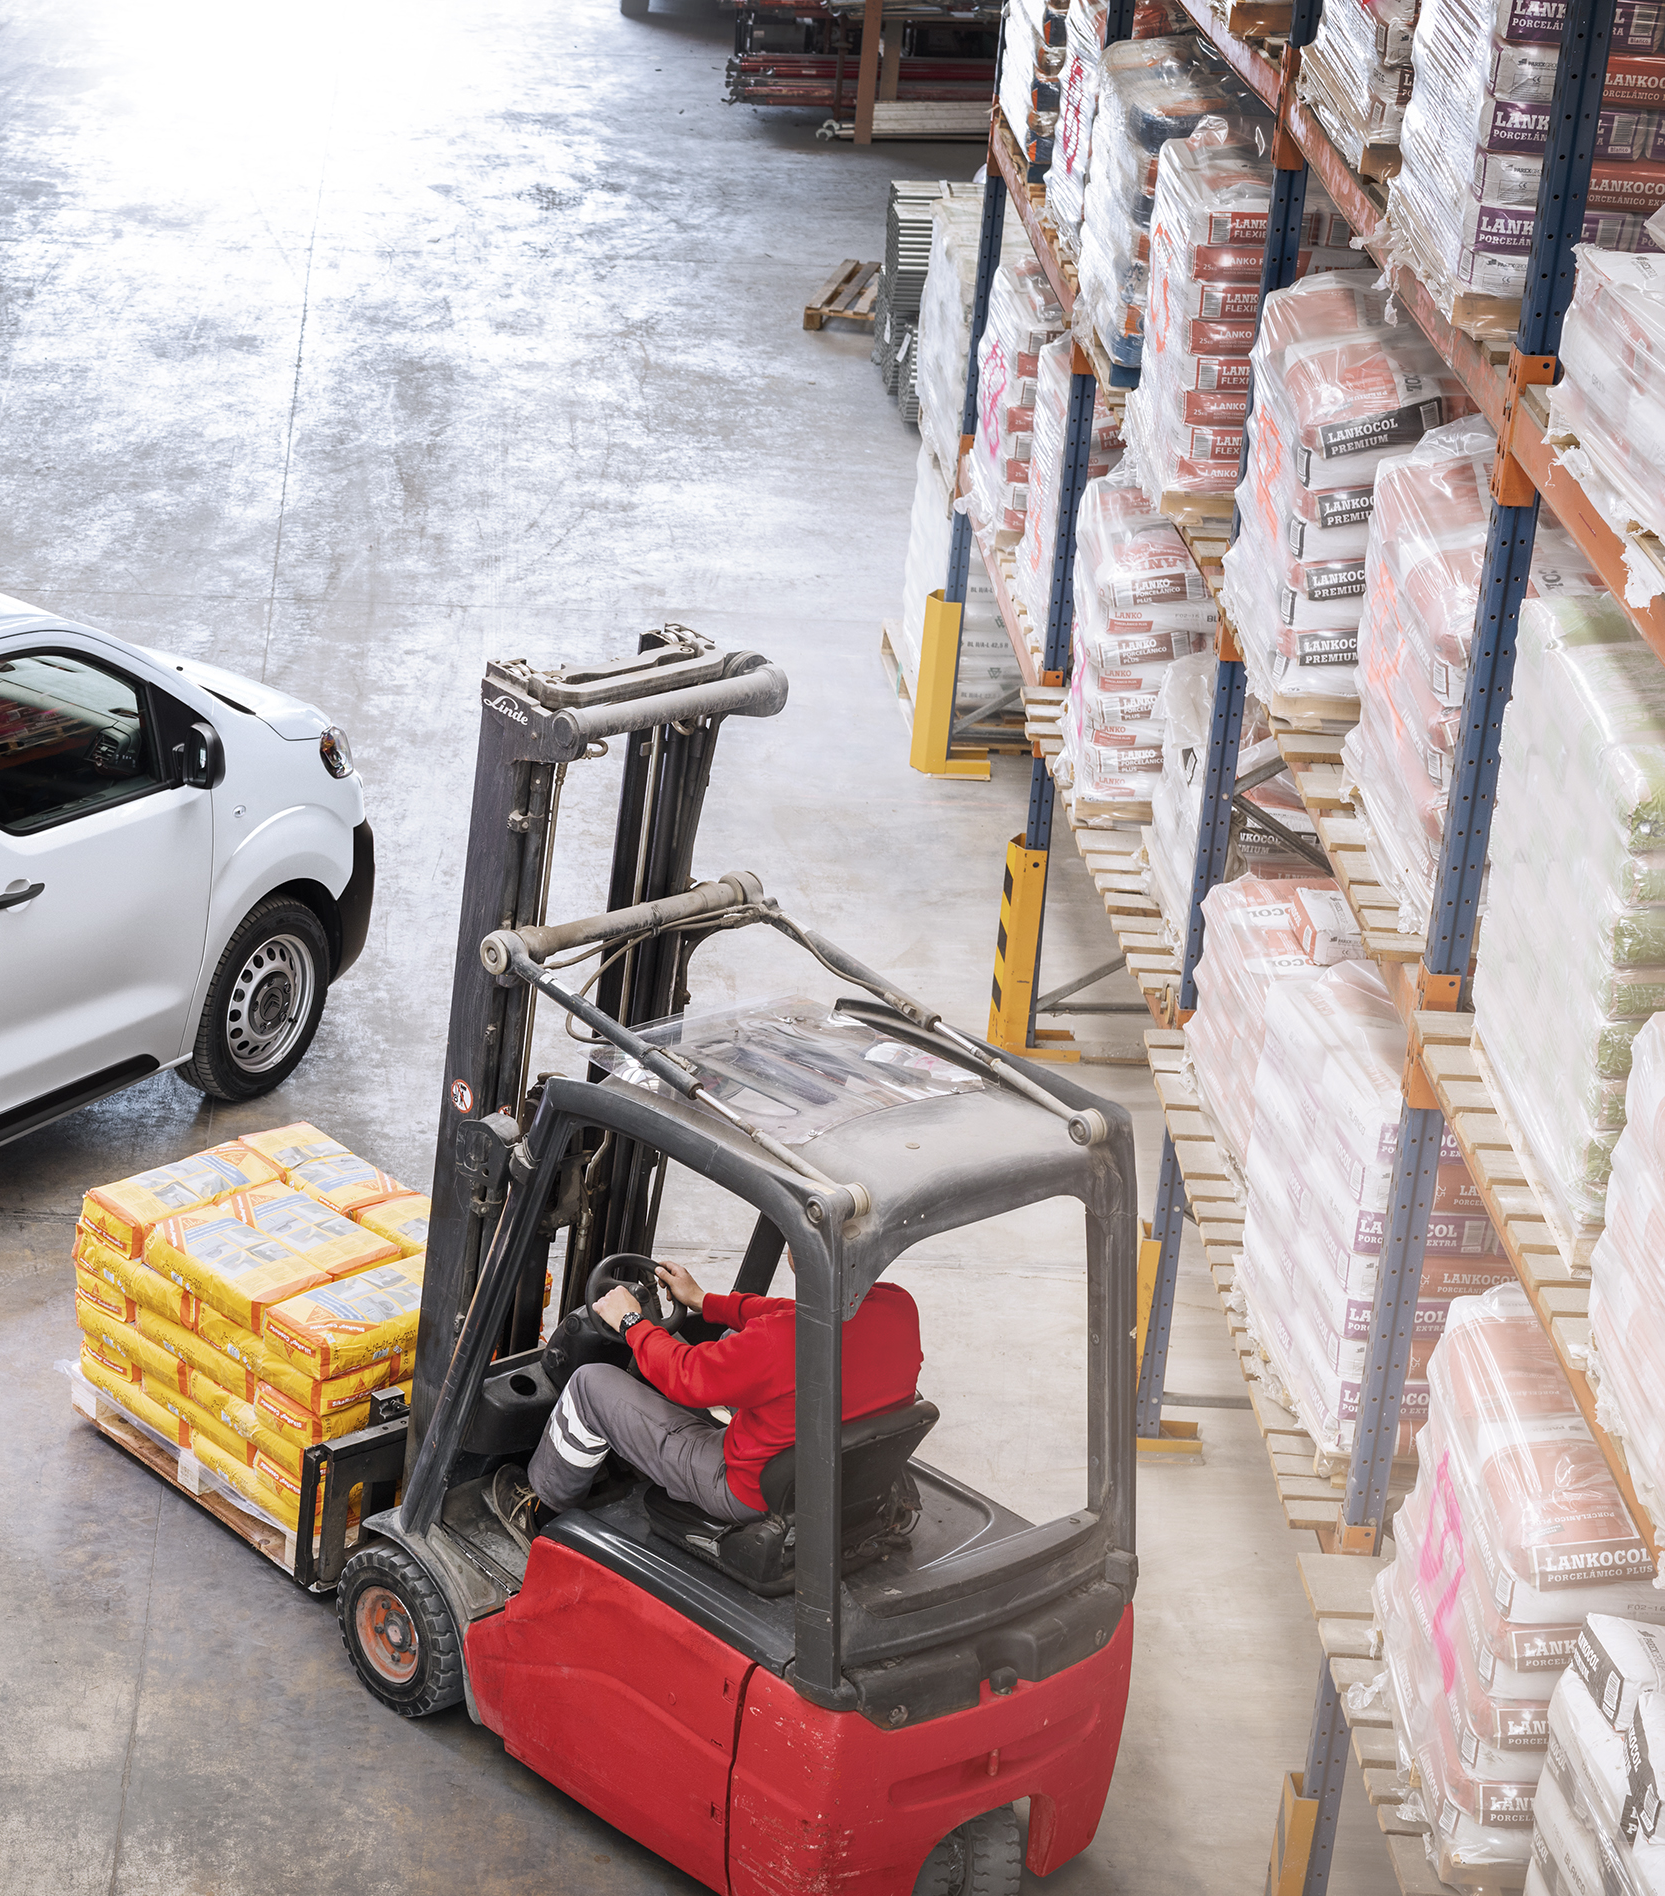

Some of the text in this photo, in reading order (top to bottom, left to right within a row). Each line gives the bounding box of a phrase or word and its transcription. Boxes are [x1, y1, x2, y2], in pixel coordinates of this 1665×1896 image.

[1514, 0, 1566, 19] LANK
[1605, 72, 1665, 90] LANKOC
[1602, 90, 1660, 101] ORCELÁNICO
[1494, 110, 1550, 131] LANK
[1493, 128, 1548, 142] PORCELÁN
[1590, 178, 1665, 196] LANKOCO
[1235, 218, 1268, 230] LANK
[1480, 215, 1534, 235] LANK
[1478, 233, 1532, 247] PORCELÁN
[1226, 293, 1259, 304] LANK
[1225, 304, 1258, 313] FLEXI
[1219, 330, 1253, 339] LANKO
[1222, 365, 1250, 376] LAN
[1327, 418, 1399, 445] LANKOCOL
[1330, 433, 1390, 455] PREMIUM
[1205, 469, 1238, 478] LANKO
[1313, 569, 1365, 588] LANKOC
[1114, 612, 1143, 620] LANKO
[1121, 638, 1157, 651] LANKO
[1304, 638, 1357, 652] LANKOC
[1104, 669, 1132, 677] LANKO
[483, 695, 529, 727] Linde
[1099, 724, 1126, 733] LANKO
[1121, 749, 1156, 760] LANKO
[184, 1217, 204, 1229] Sika
[1544, 1546, 1651, 1572] LANKOCOL
[1547, 1564, 1653, 1583] PORCELÁNICO PLUS
[1523, 1639, 1578, 1658] LANK
